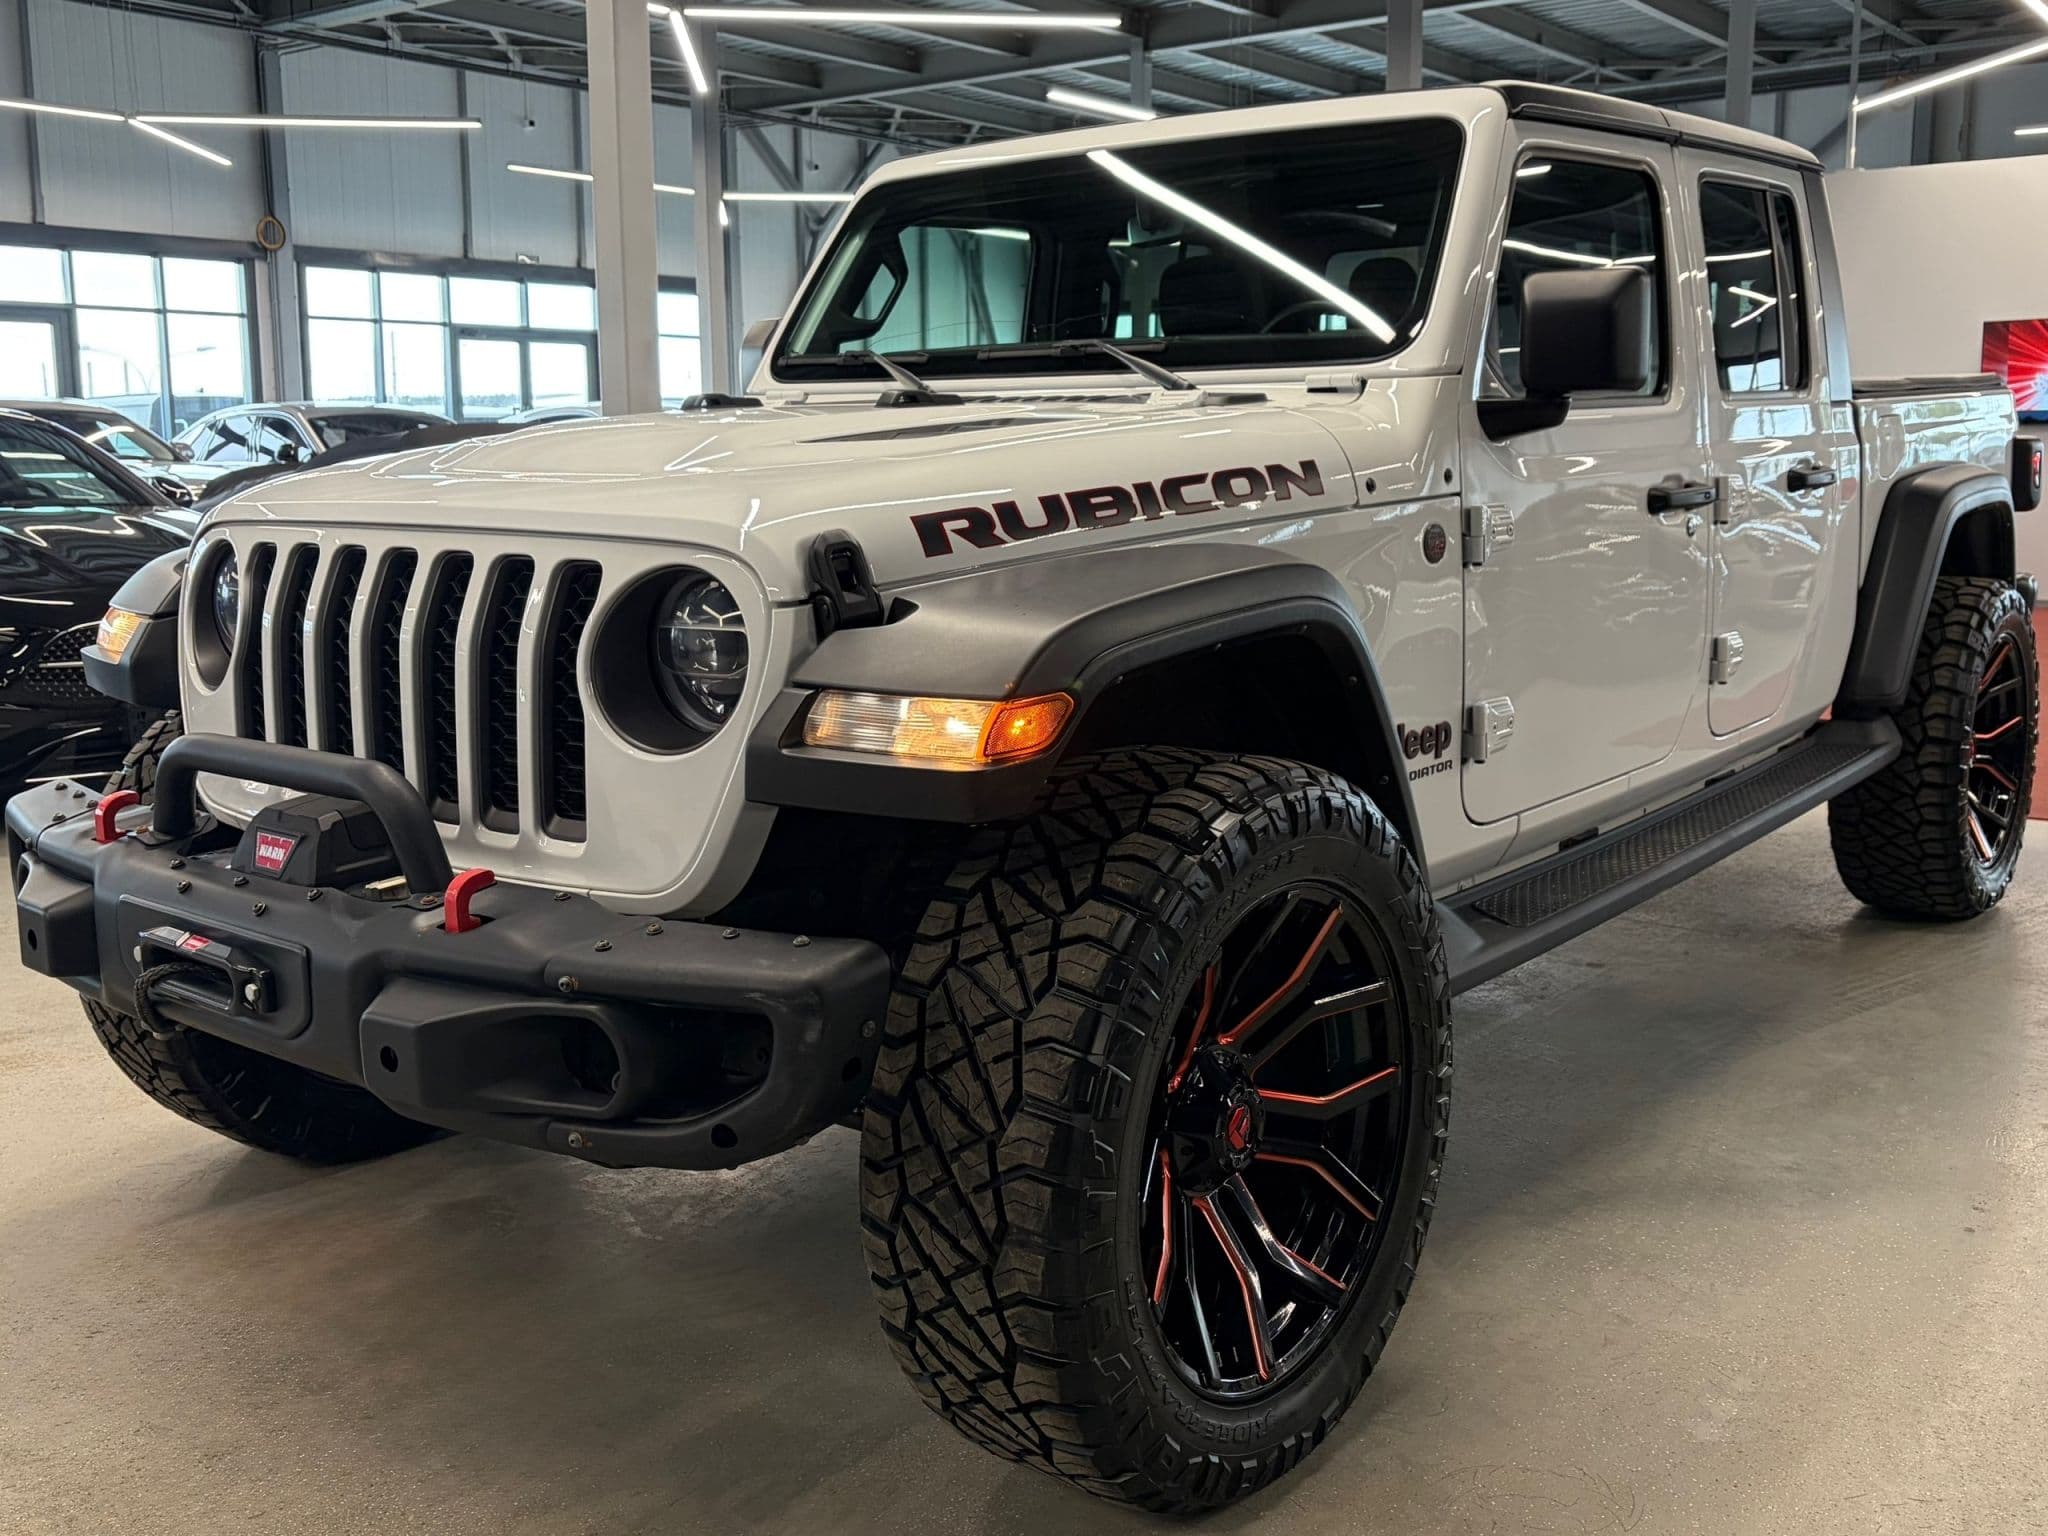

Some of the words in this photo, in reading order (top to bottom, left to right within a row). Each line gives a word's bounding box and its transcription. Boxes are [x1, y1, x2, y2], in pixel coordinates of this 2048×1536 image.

[910, 459, 1325, 558] RUBICON
[1409, 760, 1453, 781] DIATOR
[259, 843, 286, 861] WARN
